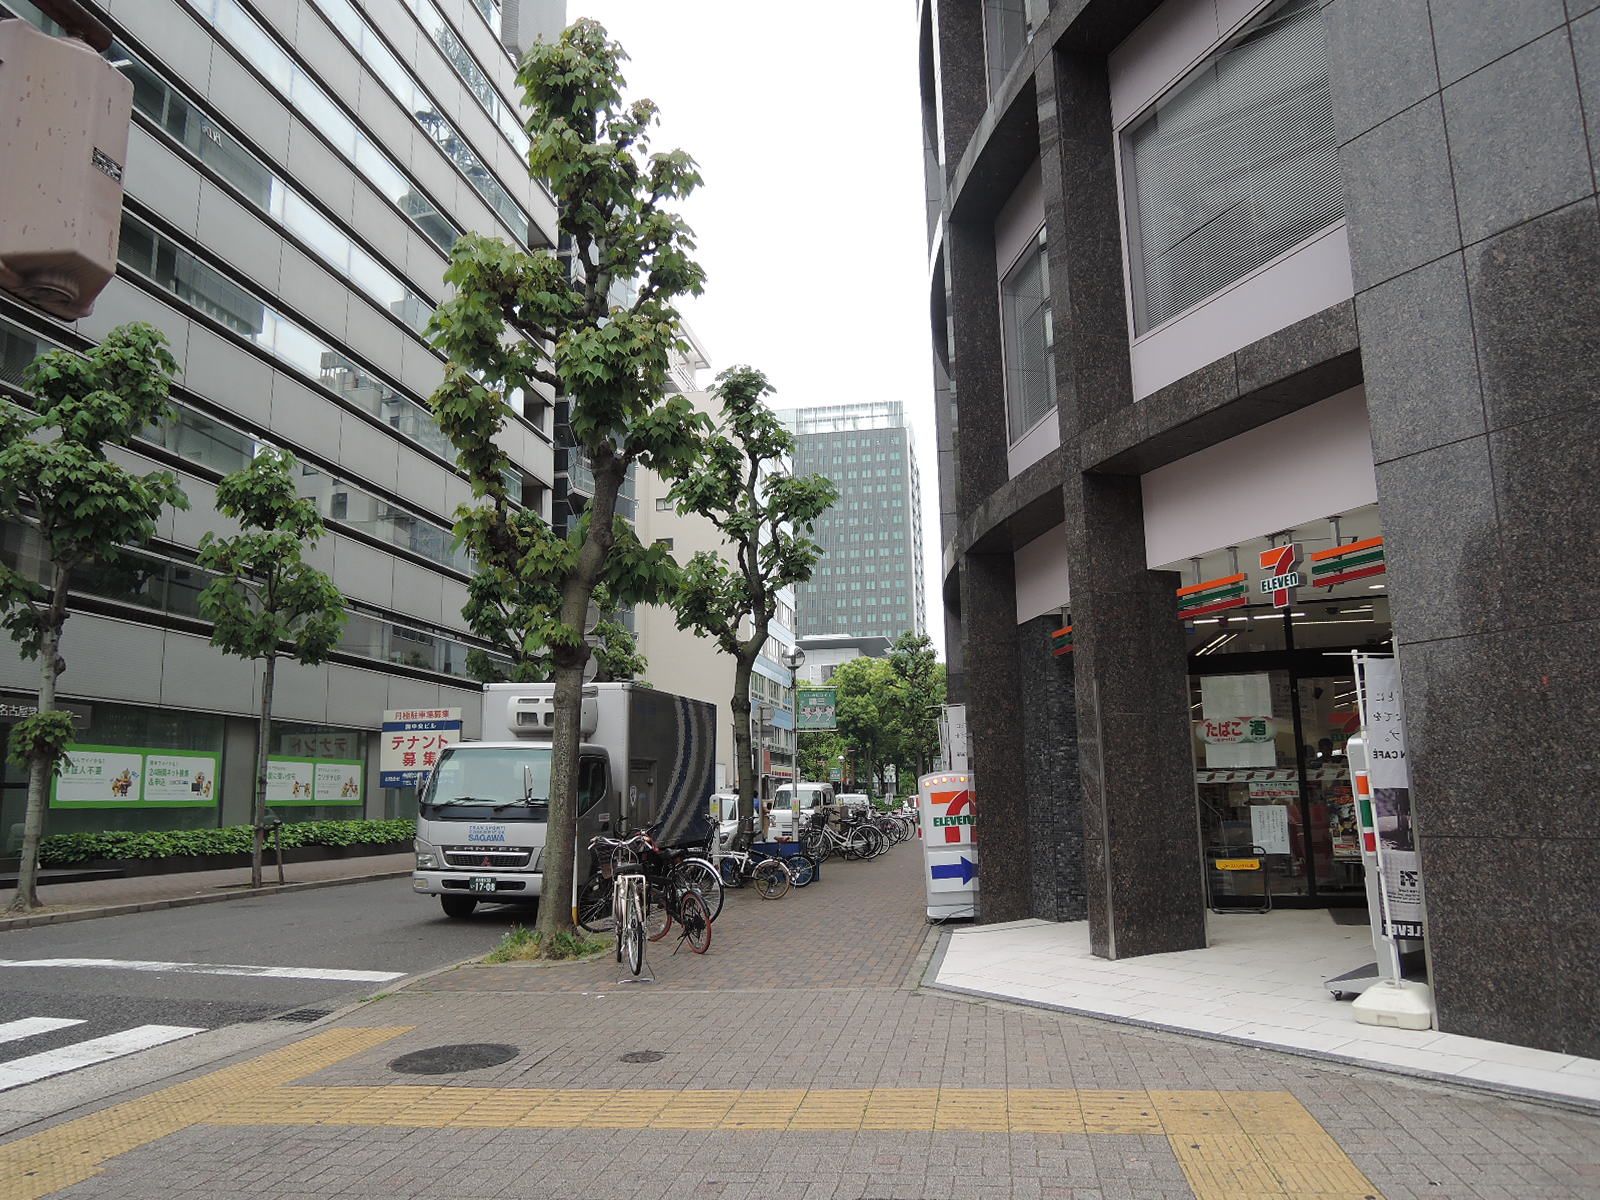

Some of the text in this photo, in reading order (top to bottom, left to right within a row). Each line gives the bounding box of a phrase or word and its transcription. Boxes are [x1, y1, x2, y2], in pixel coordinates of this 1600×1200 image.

[1205, 721, 1242, 737] たばこ
[1249, 720, 1266, 736] 酒
[392, 735, 448, 750] テナント
[403, 752, 437, 767] 募集
